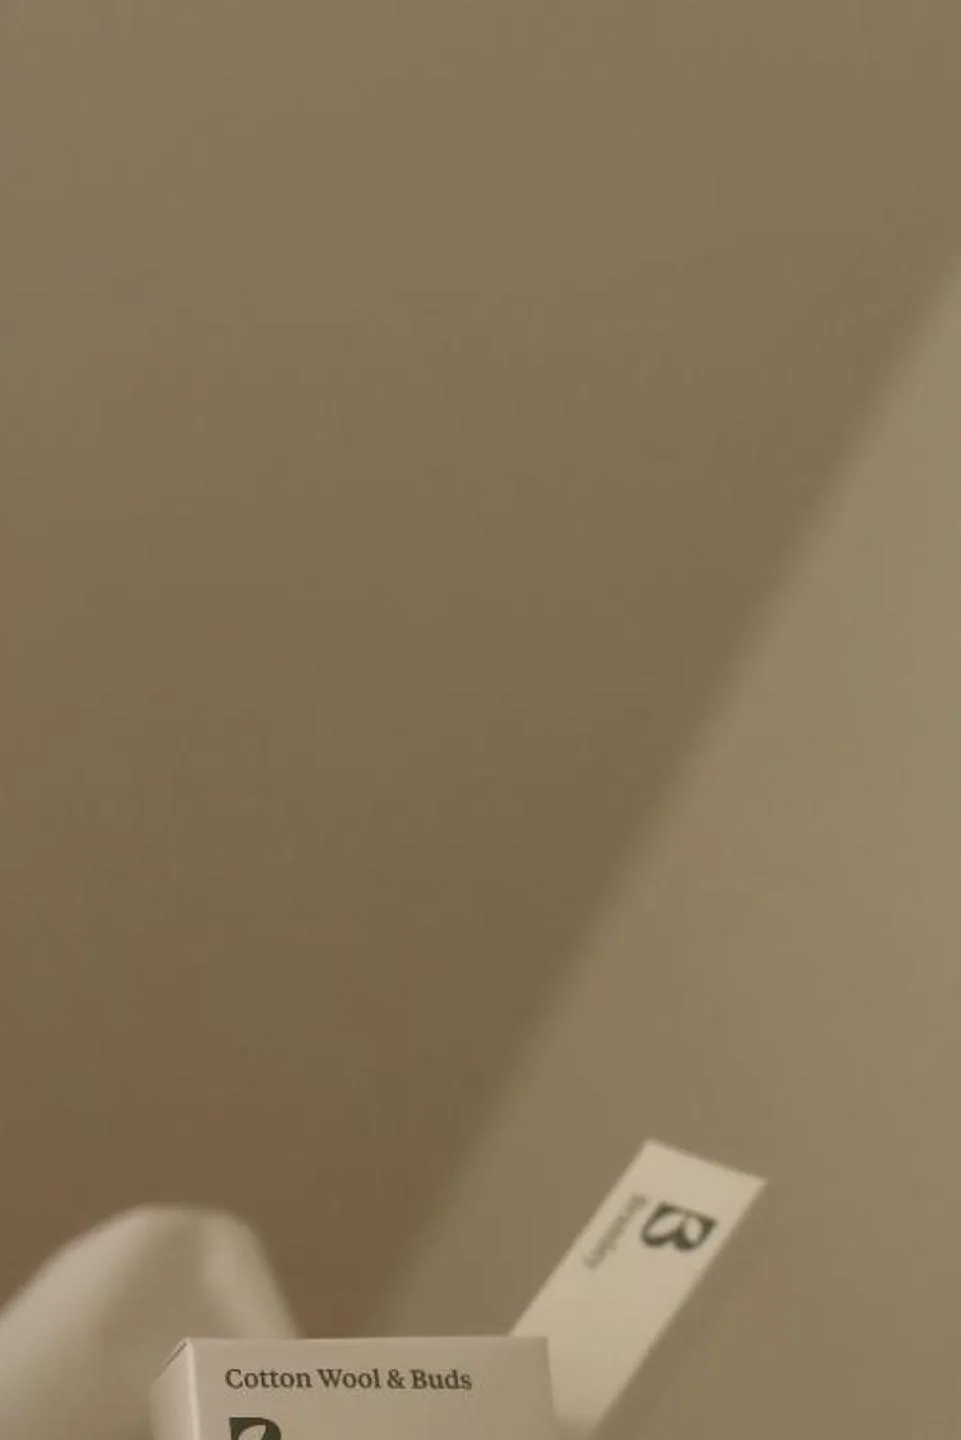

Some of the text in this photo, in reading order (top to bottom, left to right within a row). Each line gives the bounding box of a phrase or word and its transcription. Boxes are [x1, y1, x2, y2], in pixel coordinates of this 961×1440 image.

[225, 1368, 473, 1391] Cotton Wool & Buds
